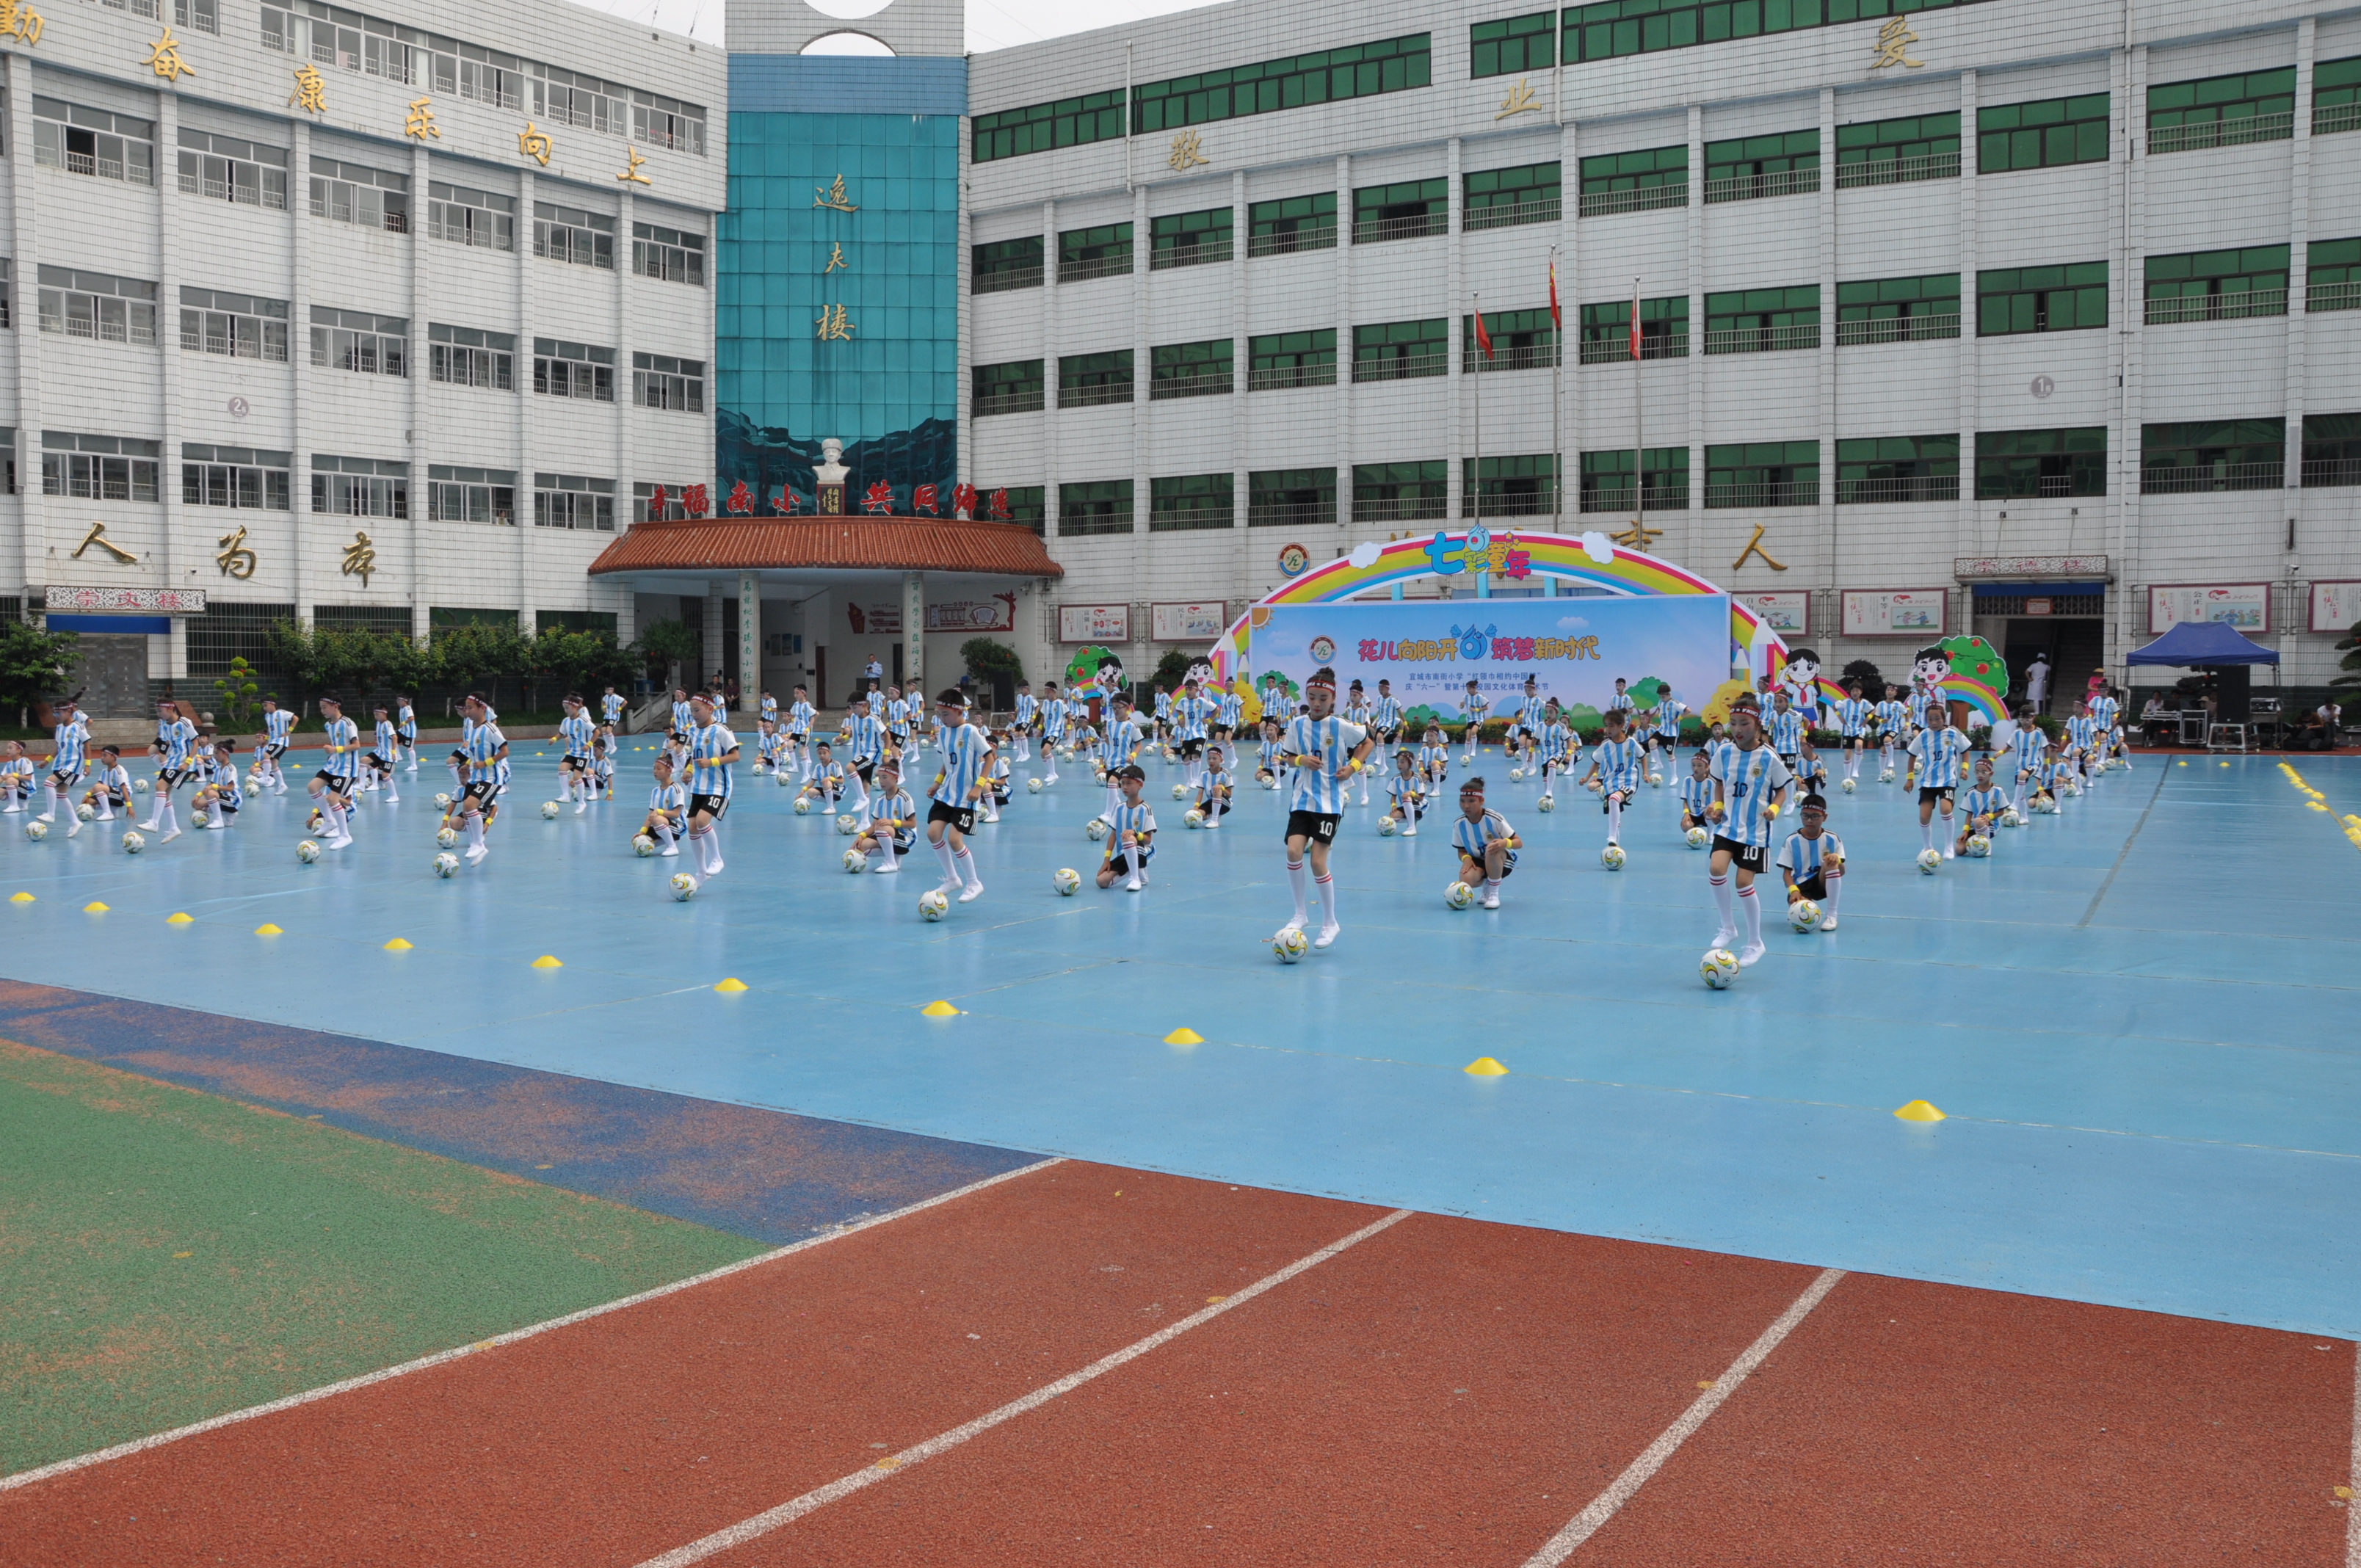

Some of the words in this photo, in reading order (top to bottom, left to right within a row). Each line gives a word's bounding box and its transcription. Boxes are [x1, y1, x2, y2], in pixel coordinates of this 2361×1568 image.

[813, 173, 860, 341] 逸夫楼
[649, 479, 801, 519] 幸福南小
[860, 479, 1012, 518] 共同缔造
[1424, 531, 1531, 581] 七彩童年
[1974, 559, 2086, 573] 崇德楼
[76, 591, 182, 609] 崇文楼
[1358, 637, 1457, 661] 花儿向阳开
[1491, 636, 1600, 661] 筑梦新时代
[1188, 711, 1195, 719] 10
[1741, 708, 1758, 716] CHINA
[1113, 738, 1120, 747] 10
[1666, 744, 1673, 752] 10
[1786, 756, 1794, 764] 10
[1932, 750, 1943, 761] 10
[576, 759, 584, 768] 10
[1614, 763, 1624, 772] 10
[1732, 781, 1748, 797] 10
[1945, 789, 1954, 799] 10
[708, 796, 720, 808] 10
[1693, 799, 1702, 807] 10
[959, 813, 971, 827] 10
[1319, 821, 1332, 836] 10
[1743, 846, 1759, 861] 10
